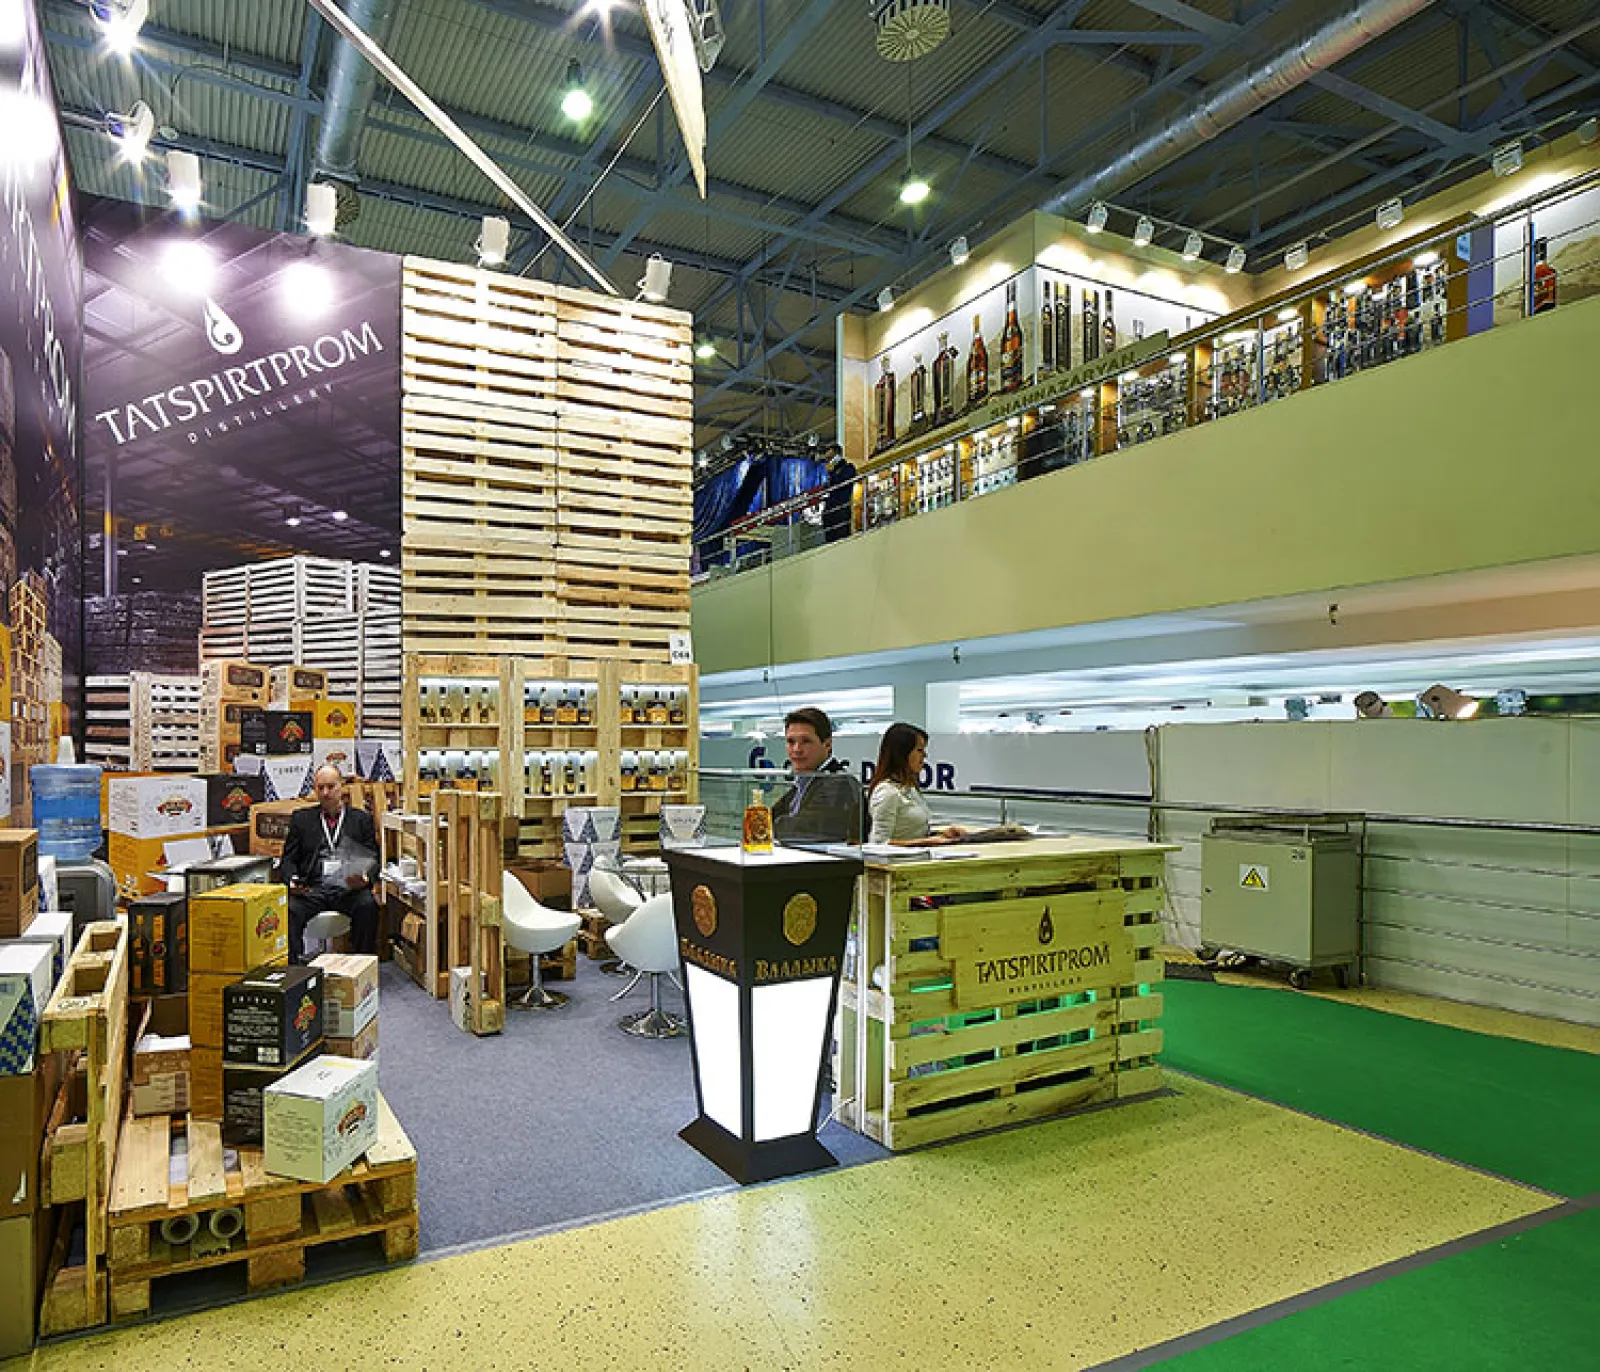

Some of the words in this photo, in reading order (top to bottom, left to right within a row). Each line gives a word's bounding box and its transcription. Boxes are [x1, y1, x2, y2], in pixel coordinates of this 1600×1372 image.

[95, 321, 383, 445] TATSPIRTPROM
[861, 761, 955, 790] DOR
[975, 941, 1111, 985] TATSPIRTPROM
